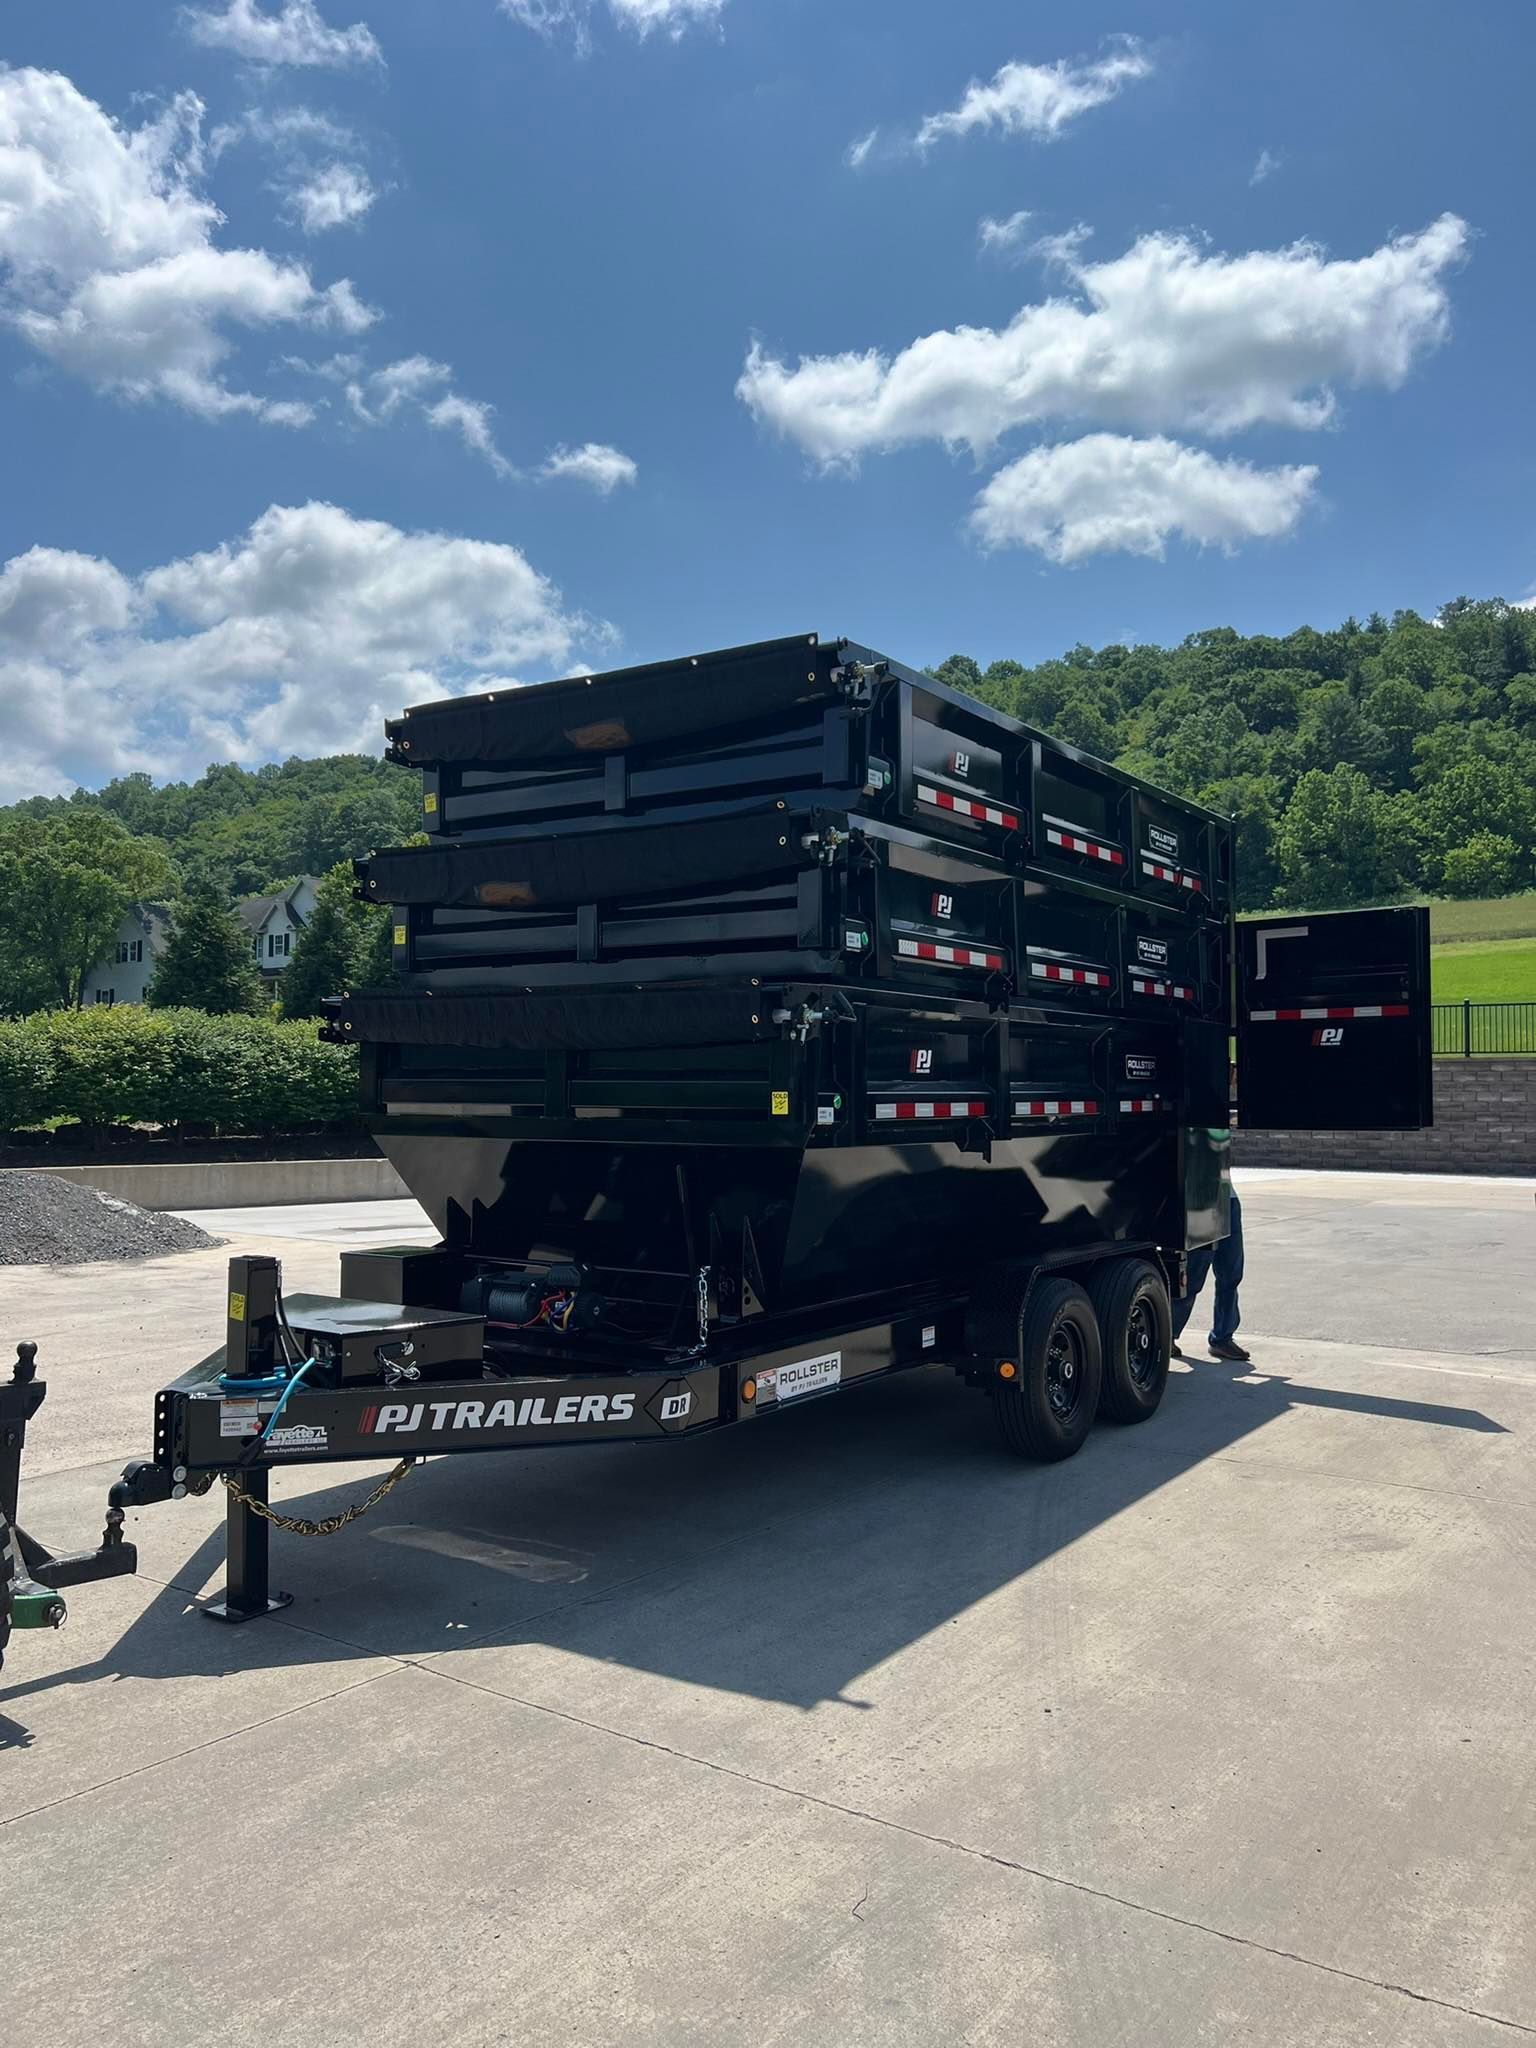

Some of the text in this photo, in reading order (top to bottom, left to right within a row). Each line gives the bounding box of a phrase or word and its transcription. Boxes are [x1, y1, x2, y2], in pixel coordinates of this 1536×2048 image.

[955, 751, 969, 772] PJ
[1150, 829, 1177, 847] ROLLSTER
[937, 894, 953, 914] PJ
[1138, 940, 1166, 955] ROLLSTER
[1320, 1028, 1344, 1042] PJ
[916, 1049, 932, 1068] PJ
[1127, 1059, 1156, 1070] ROLLSTER
[780, 1359, 838, 1385] ROLLSTER
[374, 1393, 636, 1433] PJ TRAILERS
[668, 1397, 687, 1416] DR
[263, 1446, 329, 1454] www.fayettetrailers.com
